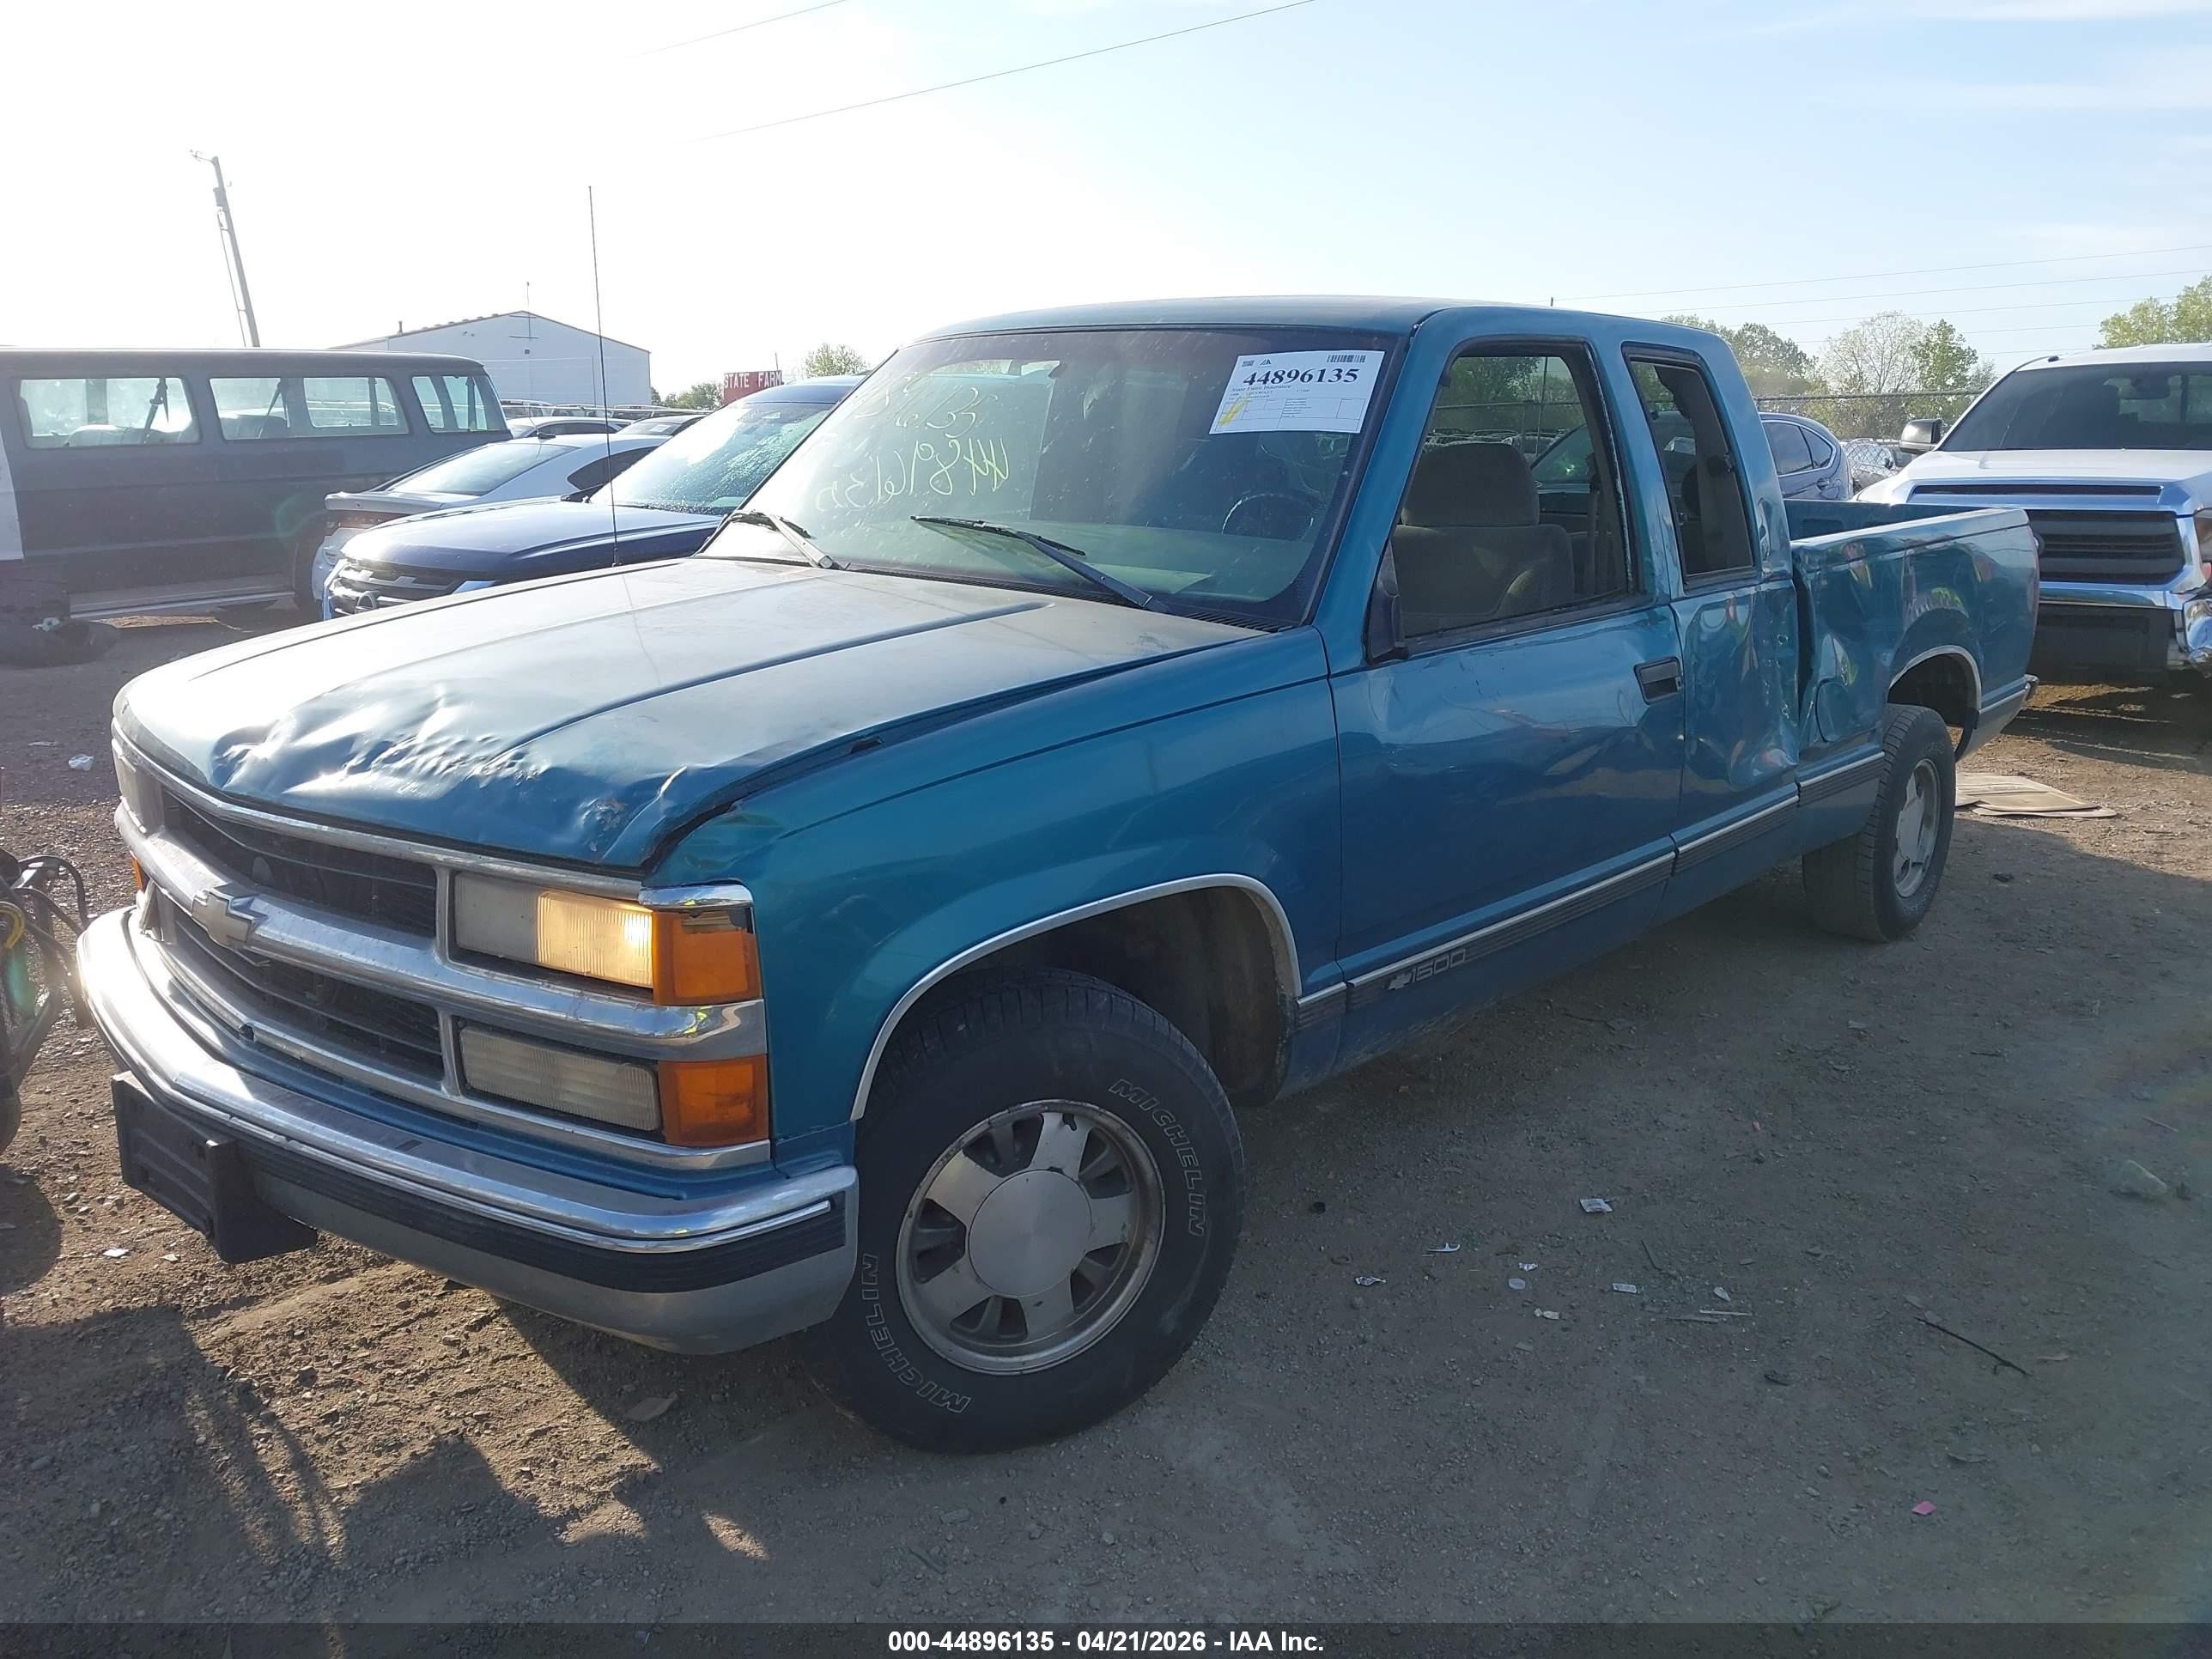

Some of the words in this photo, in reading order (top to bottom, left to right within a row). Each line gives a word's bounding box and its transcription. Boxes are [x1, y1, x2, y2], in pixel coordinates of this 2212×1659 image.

[724, 373, 750, 389] STATE
[758, 370, 782, 387] FARM
[1243, 368, 1360, 386] 44896135
[1412, 948, 1466, 983] 1500
[1108, 1079, 1206, 1237] MICHELIN
[861, 1253, 971, 1413] MICHELIN
